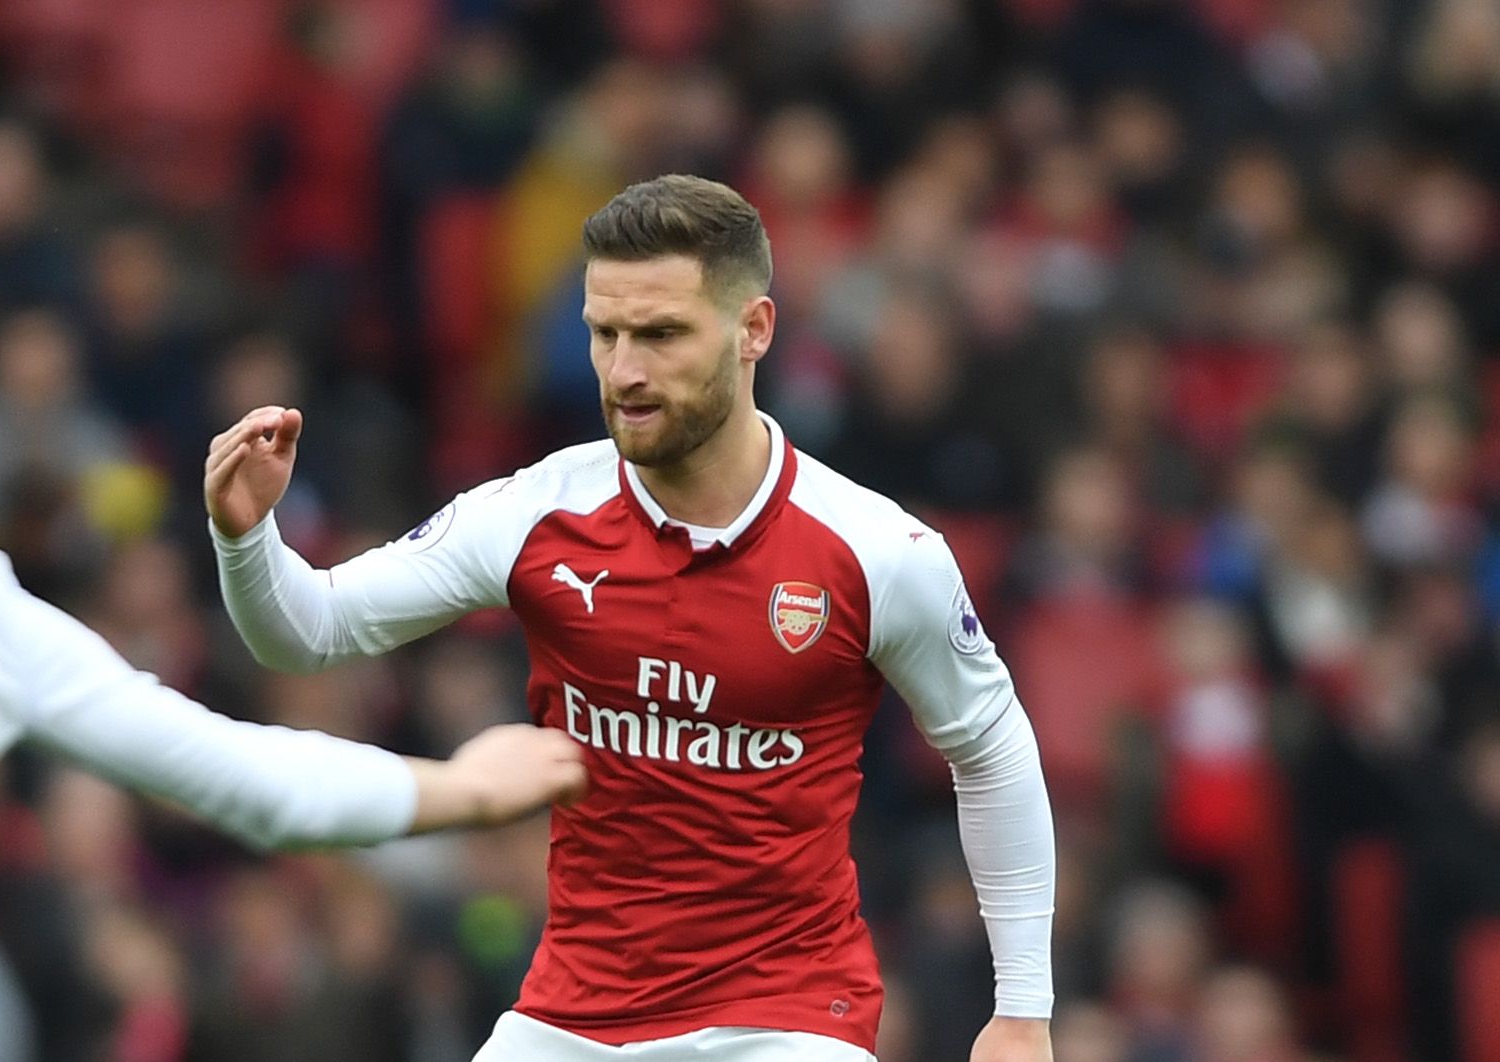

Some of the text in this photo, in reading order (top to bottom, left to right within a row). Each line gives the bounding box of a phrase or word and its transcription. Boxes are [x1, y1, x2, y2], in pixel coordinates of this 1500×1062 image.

[780, 591, 822, 609] Arsenal
[638, 656, 717, 713] Fly
[562, 681, 804, 770] Emirates
